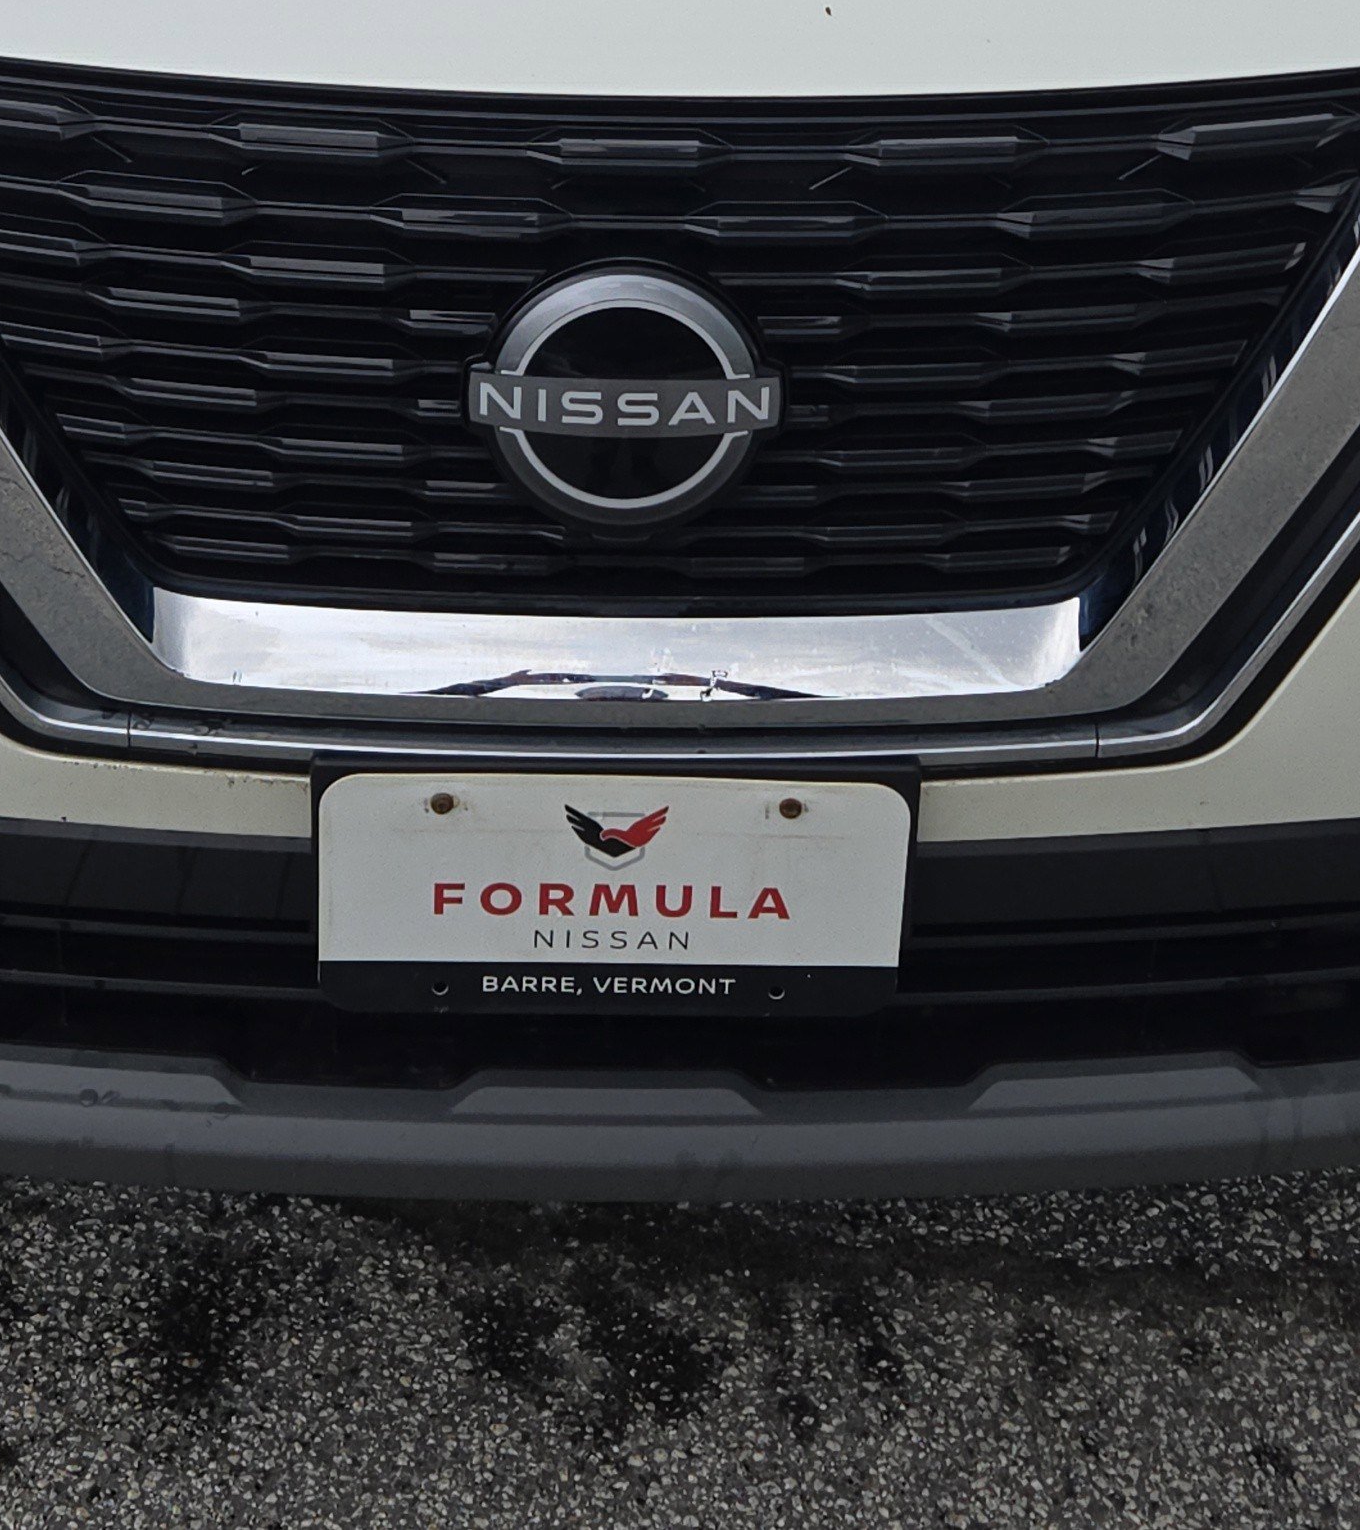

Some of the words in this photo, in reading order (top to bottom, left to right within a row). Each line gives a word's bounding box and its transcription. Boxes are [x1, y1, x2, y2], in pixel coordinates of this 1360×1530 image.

[478, 381, 770, 427] NISSAN
[433, 881, 791, 920] FORMULA
[532, 928, 691, 951] NISSAN
[481, 975, 583, 997] BARRE,
[592, 976, 737, 997] VERMONT
